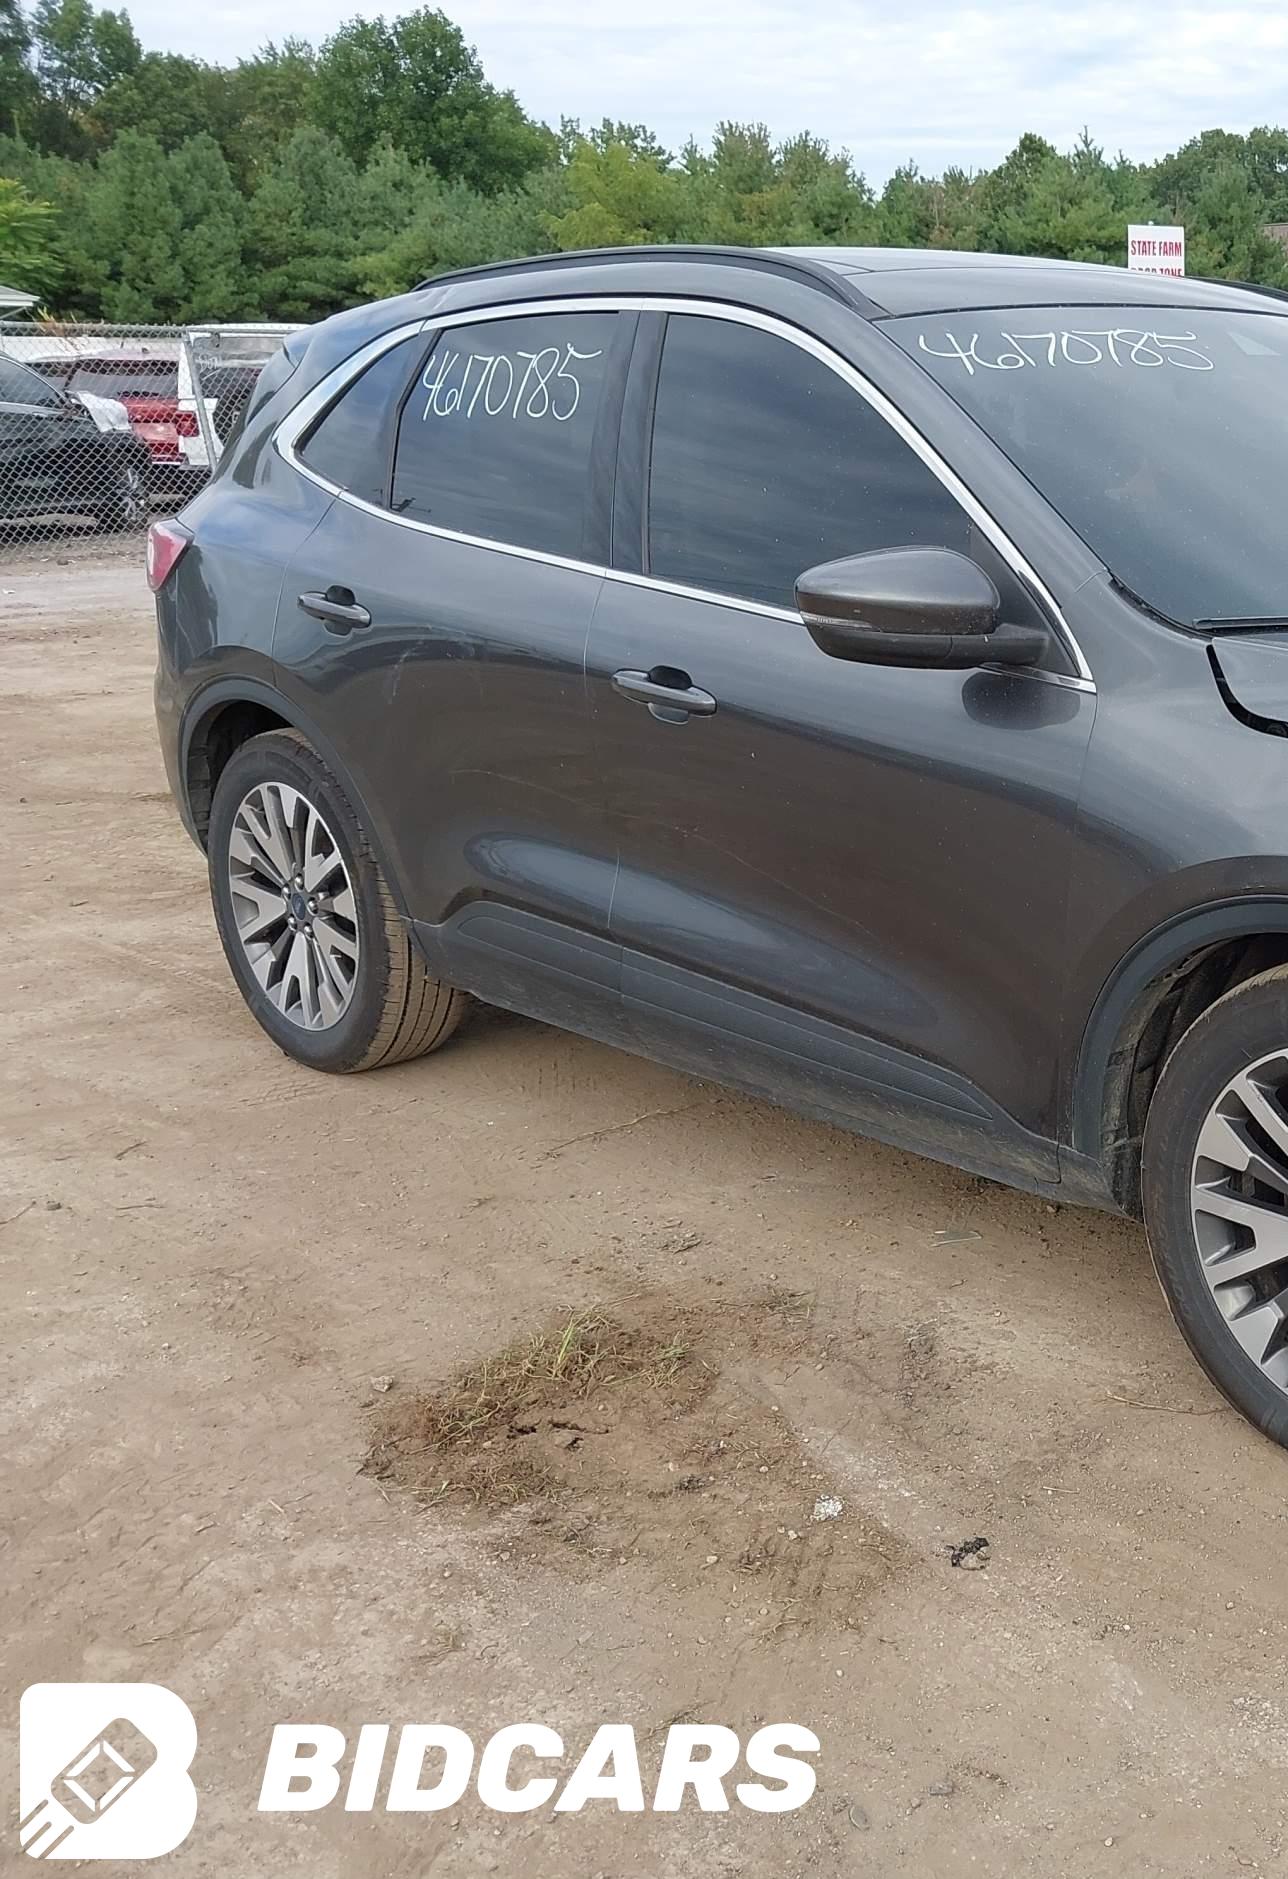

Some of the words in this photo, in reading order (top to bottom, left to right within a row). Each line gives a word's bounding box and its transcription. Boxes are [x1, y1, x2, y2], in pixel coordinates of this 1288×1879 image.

[1131, 240, 1157, 256] STATE
[1159, 241, 1182, 257] FARM
[919, 328, 1214, 375] 46170785
[422, 342, 602, 421] 46170785
